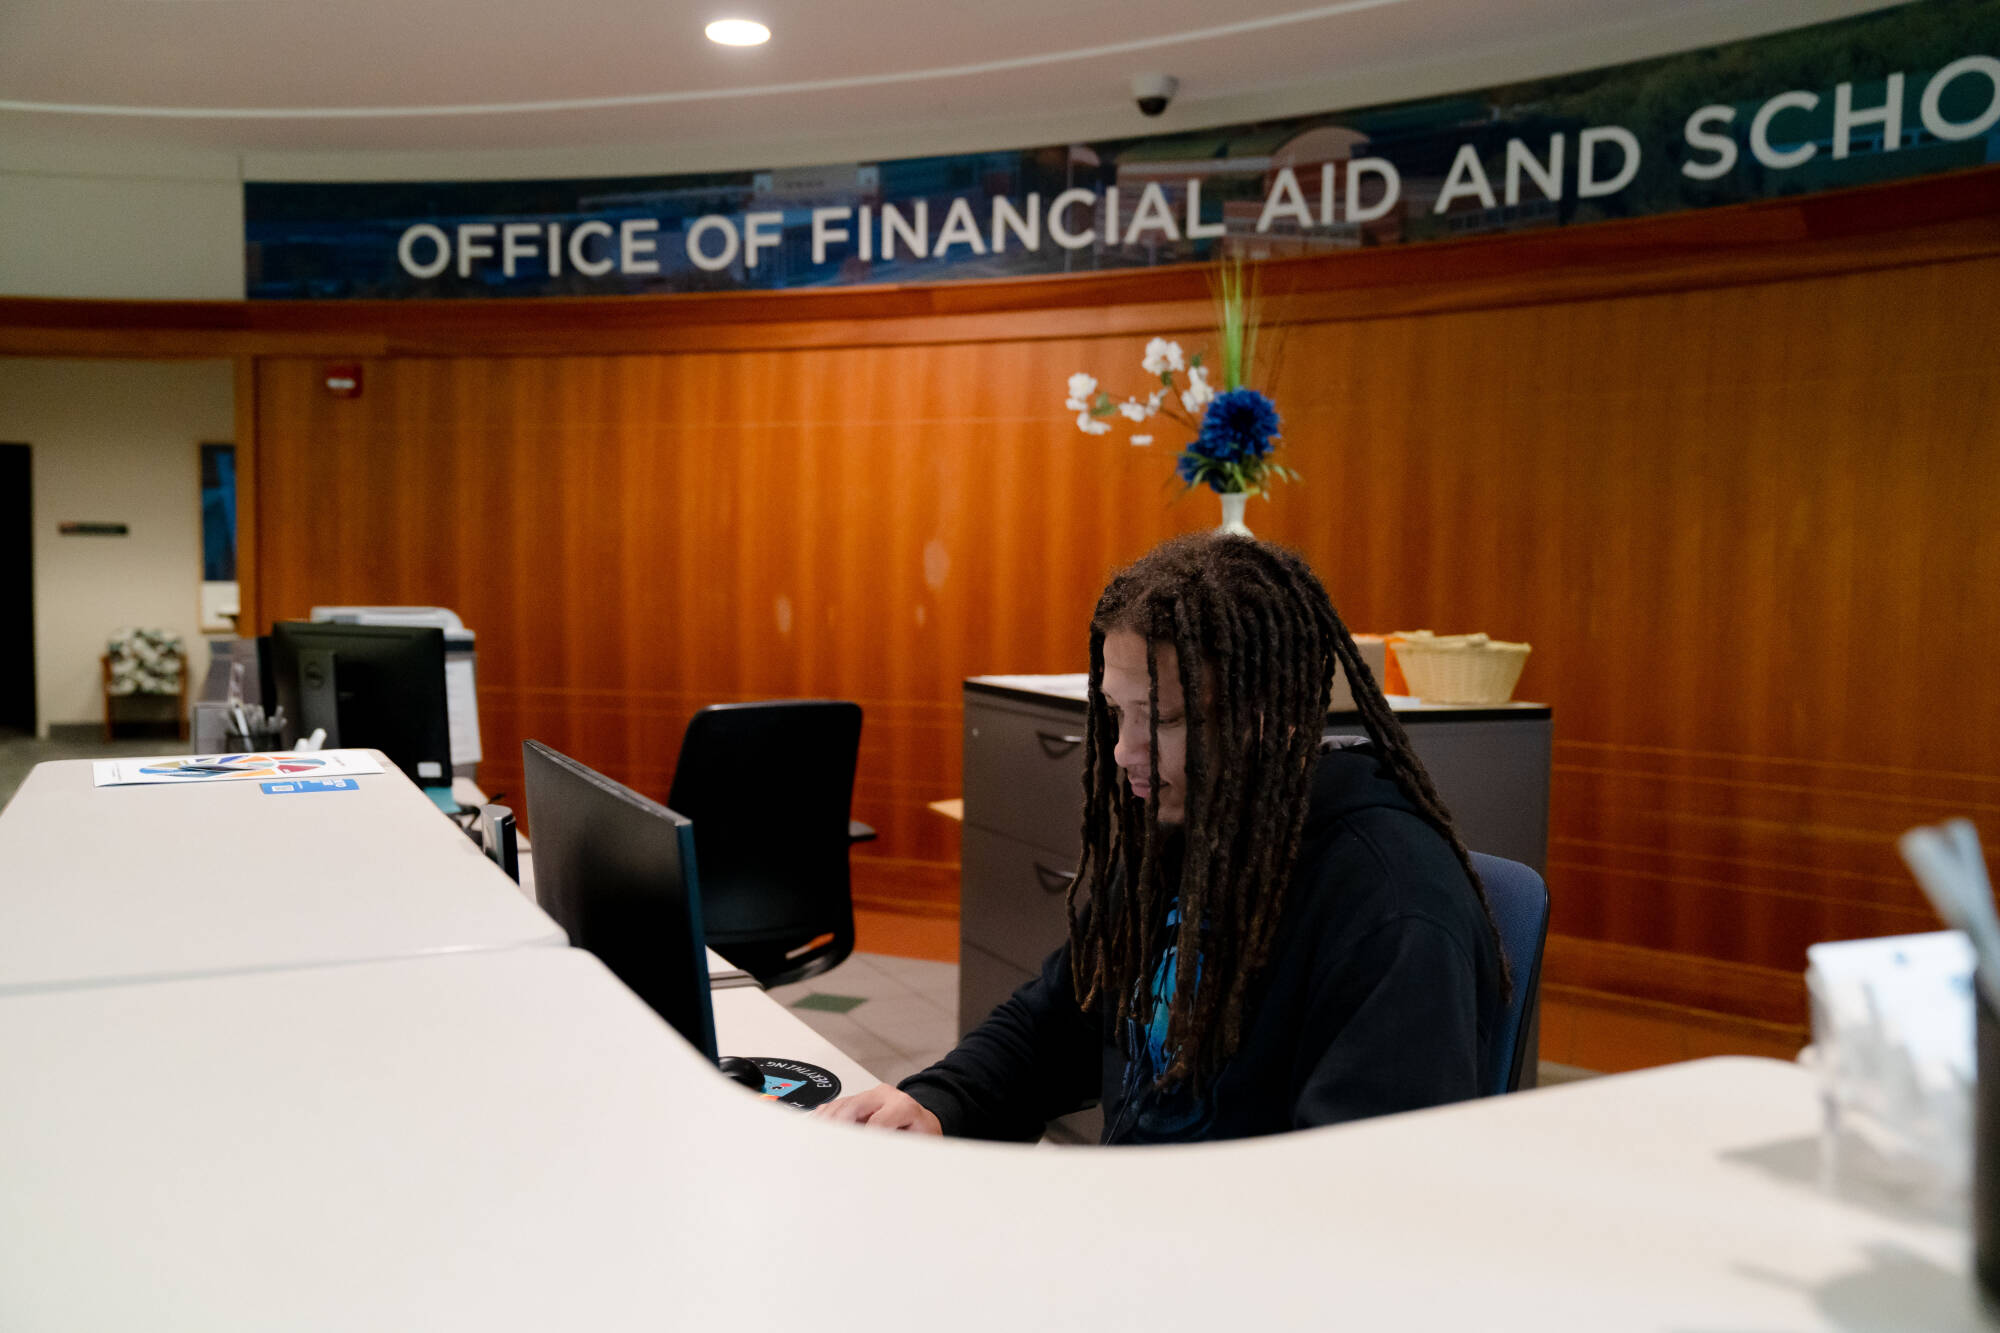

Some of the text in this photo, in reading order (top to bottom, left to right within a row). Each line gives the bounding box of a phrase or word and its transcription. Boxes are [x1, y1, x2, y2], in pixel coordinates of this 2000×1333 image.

[398, 56, 2000, 278] OFFICE OF FINANCIAL AID AND SCHO
